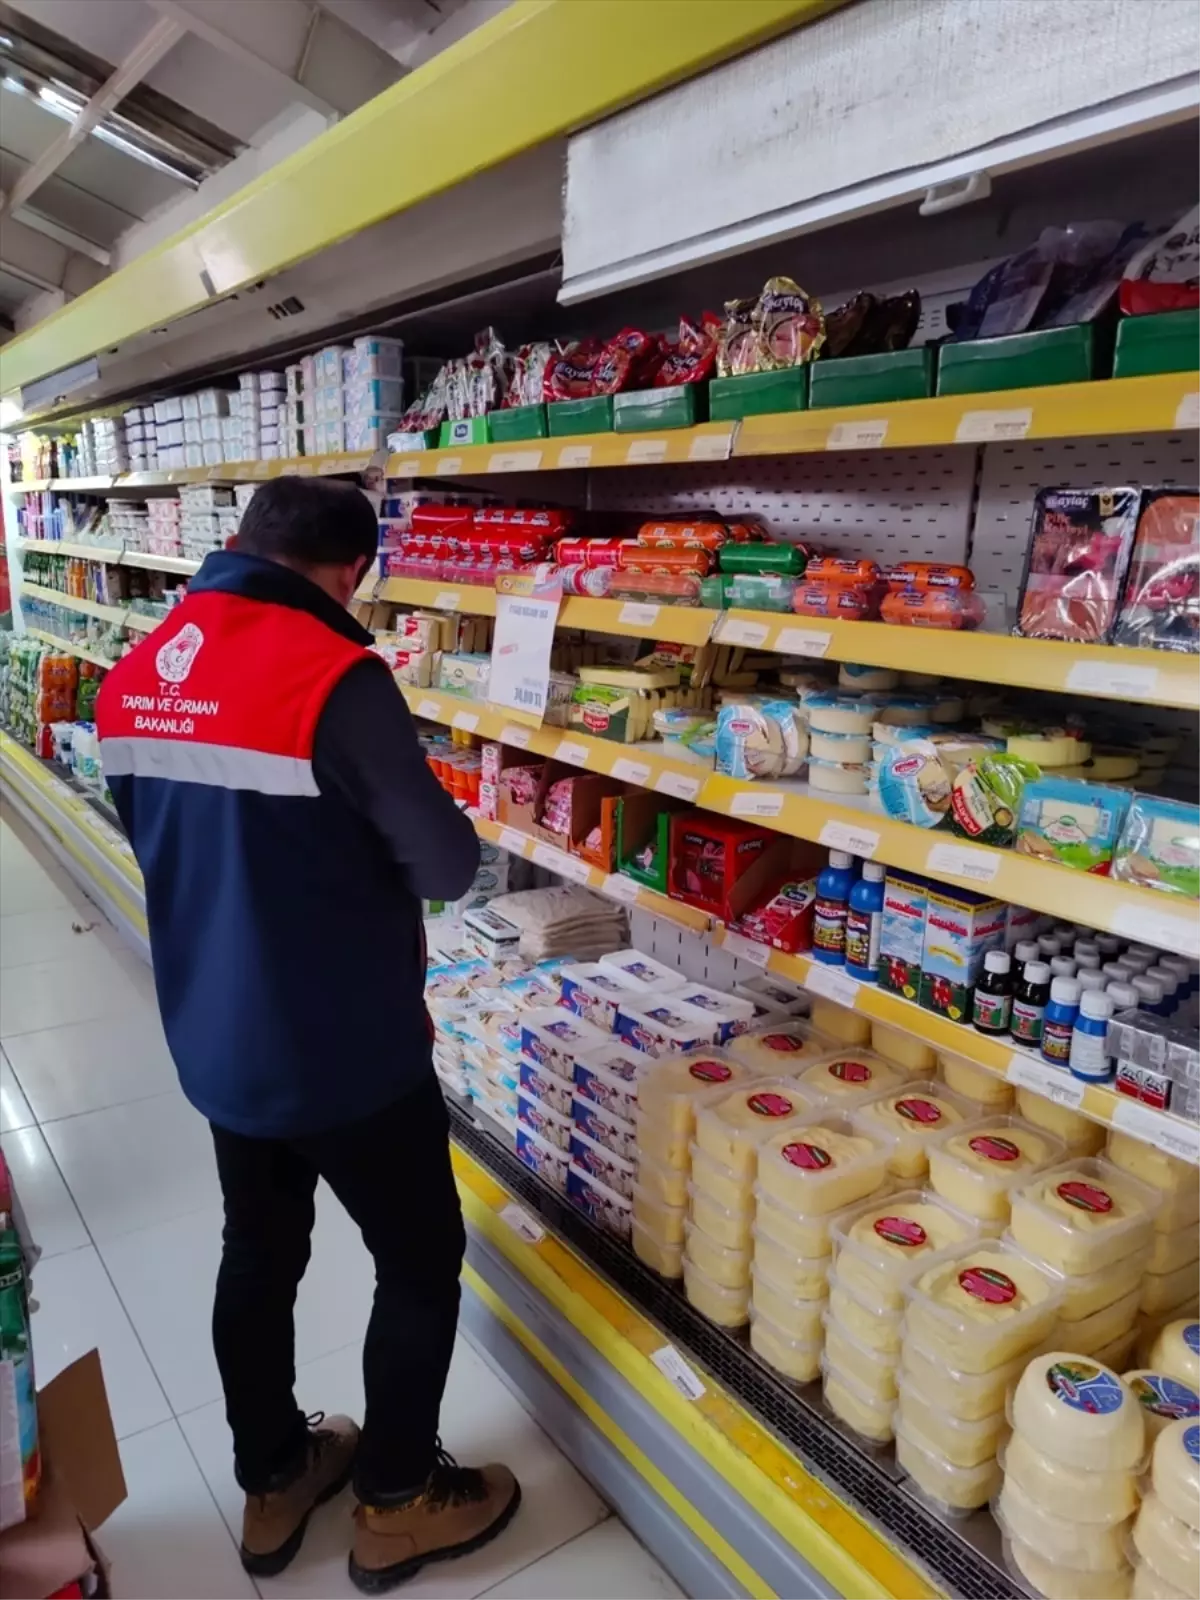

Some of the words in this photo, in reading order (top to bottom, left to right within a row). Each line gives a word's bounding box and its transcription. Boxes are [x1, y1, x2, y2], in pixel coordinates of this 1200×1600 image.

[121, 694, 154, 711] TARIM
[156, 697, 173, 712] VE
[174, 699, 219, 716] ORMAN
[134, 715, 194, 735] BAKANLIĞI
